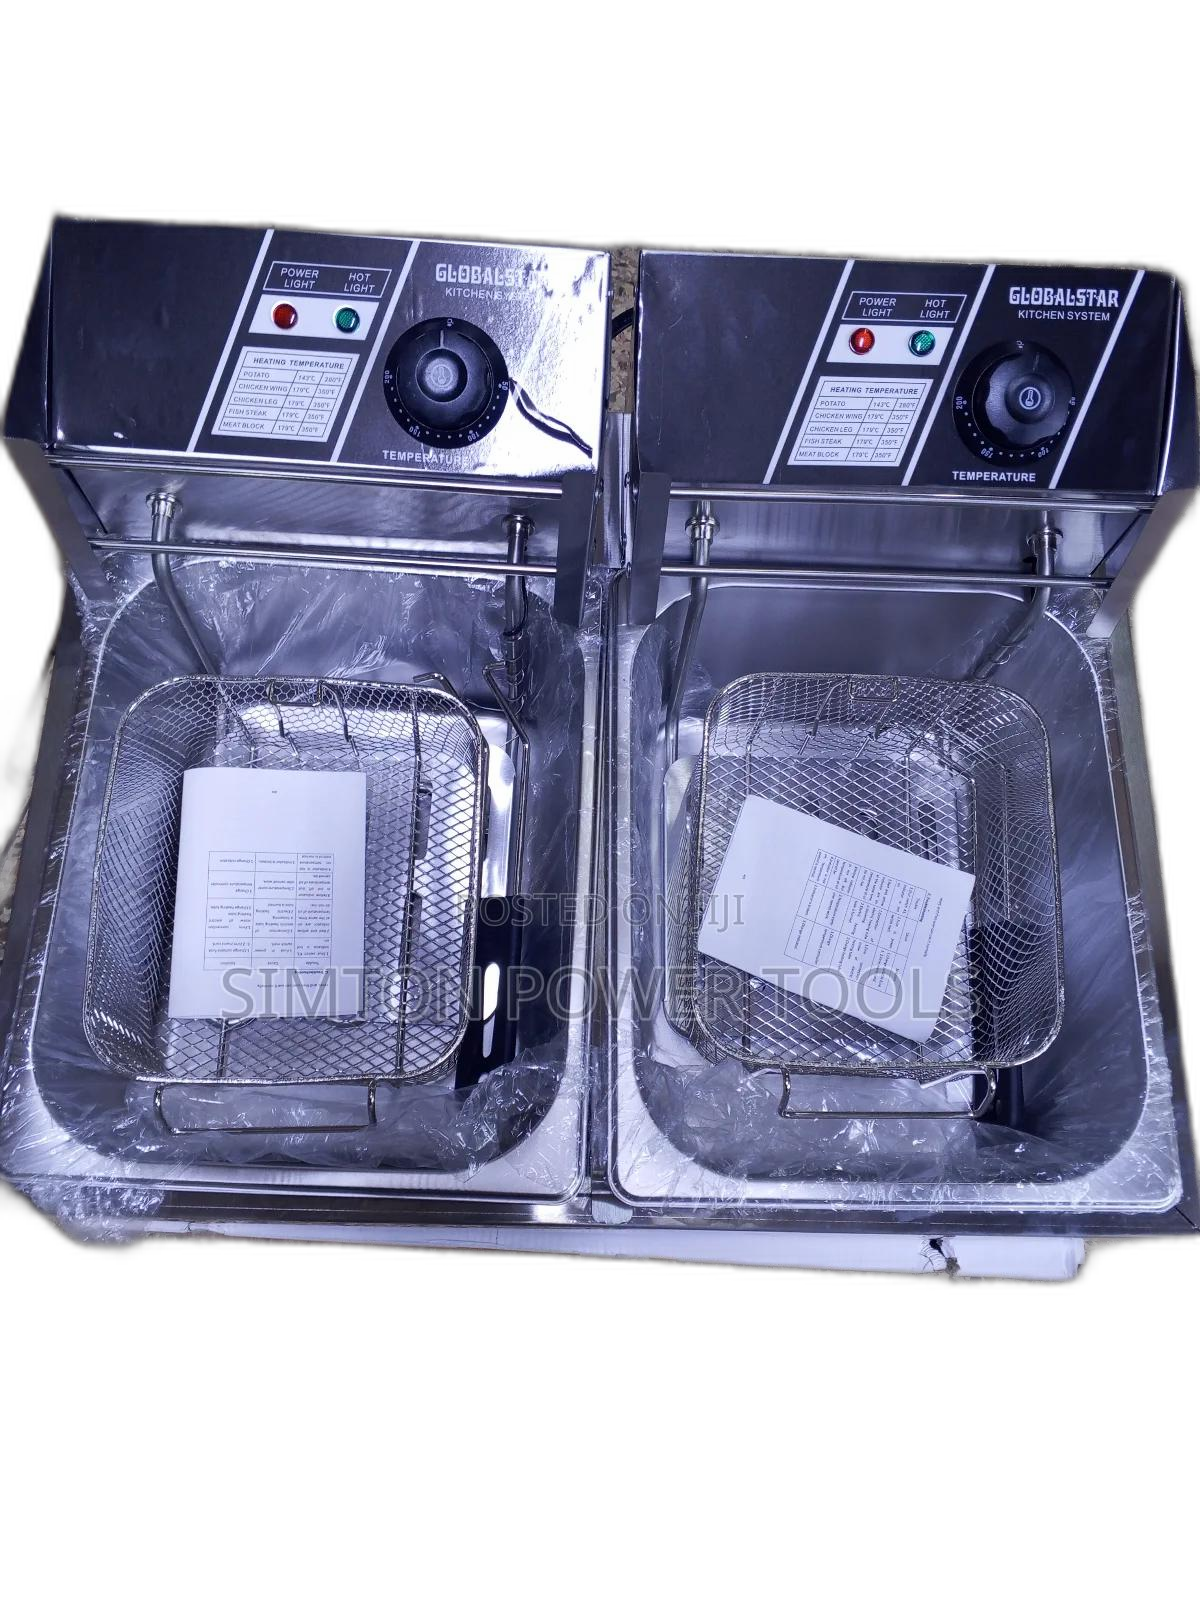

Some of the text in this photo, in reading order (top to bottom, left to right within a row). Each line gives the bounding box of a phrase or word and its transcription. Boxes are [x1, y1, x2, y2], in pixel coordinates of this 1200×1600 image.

[281, 267, 319, 279] POWER
[348, 272, 370, 282] HOT
[435, 263, 538, 286] GLOBALSTA
[284, 279, 315, 290] LIGHT
[344, 283, 375, 293] LIGHT
[445, 288, 495, 299] KITCHEN
[1009, 286, 1119, 308] GLOBALSTAR
[859, 297, 896, 307] POWER
[925, 299, 946, 308] HOT
[862, 309, 892, 317] LIGHT
[920, 309, 950, 319] LIGHT
[1018, 310, 1110, 321] KITCHEN SYSTEM
[290, 360, 344, 369] TEMPERATURE
[952, 471, 1036, 482] TEMPERATURE
